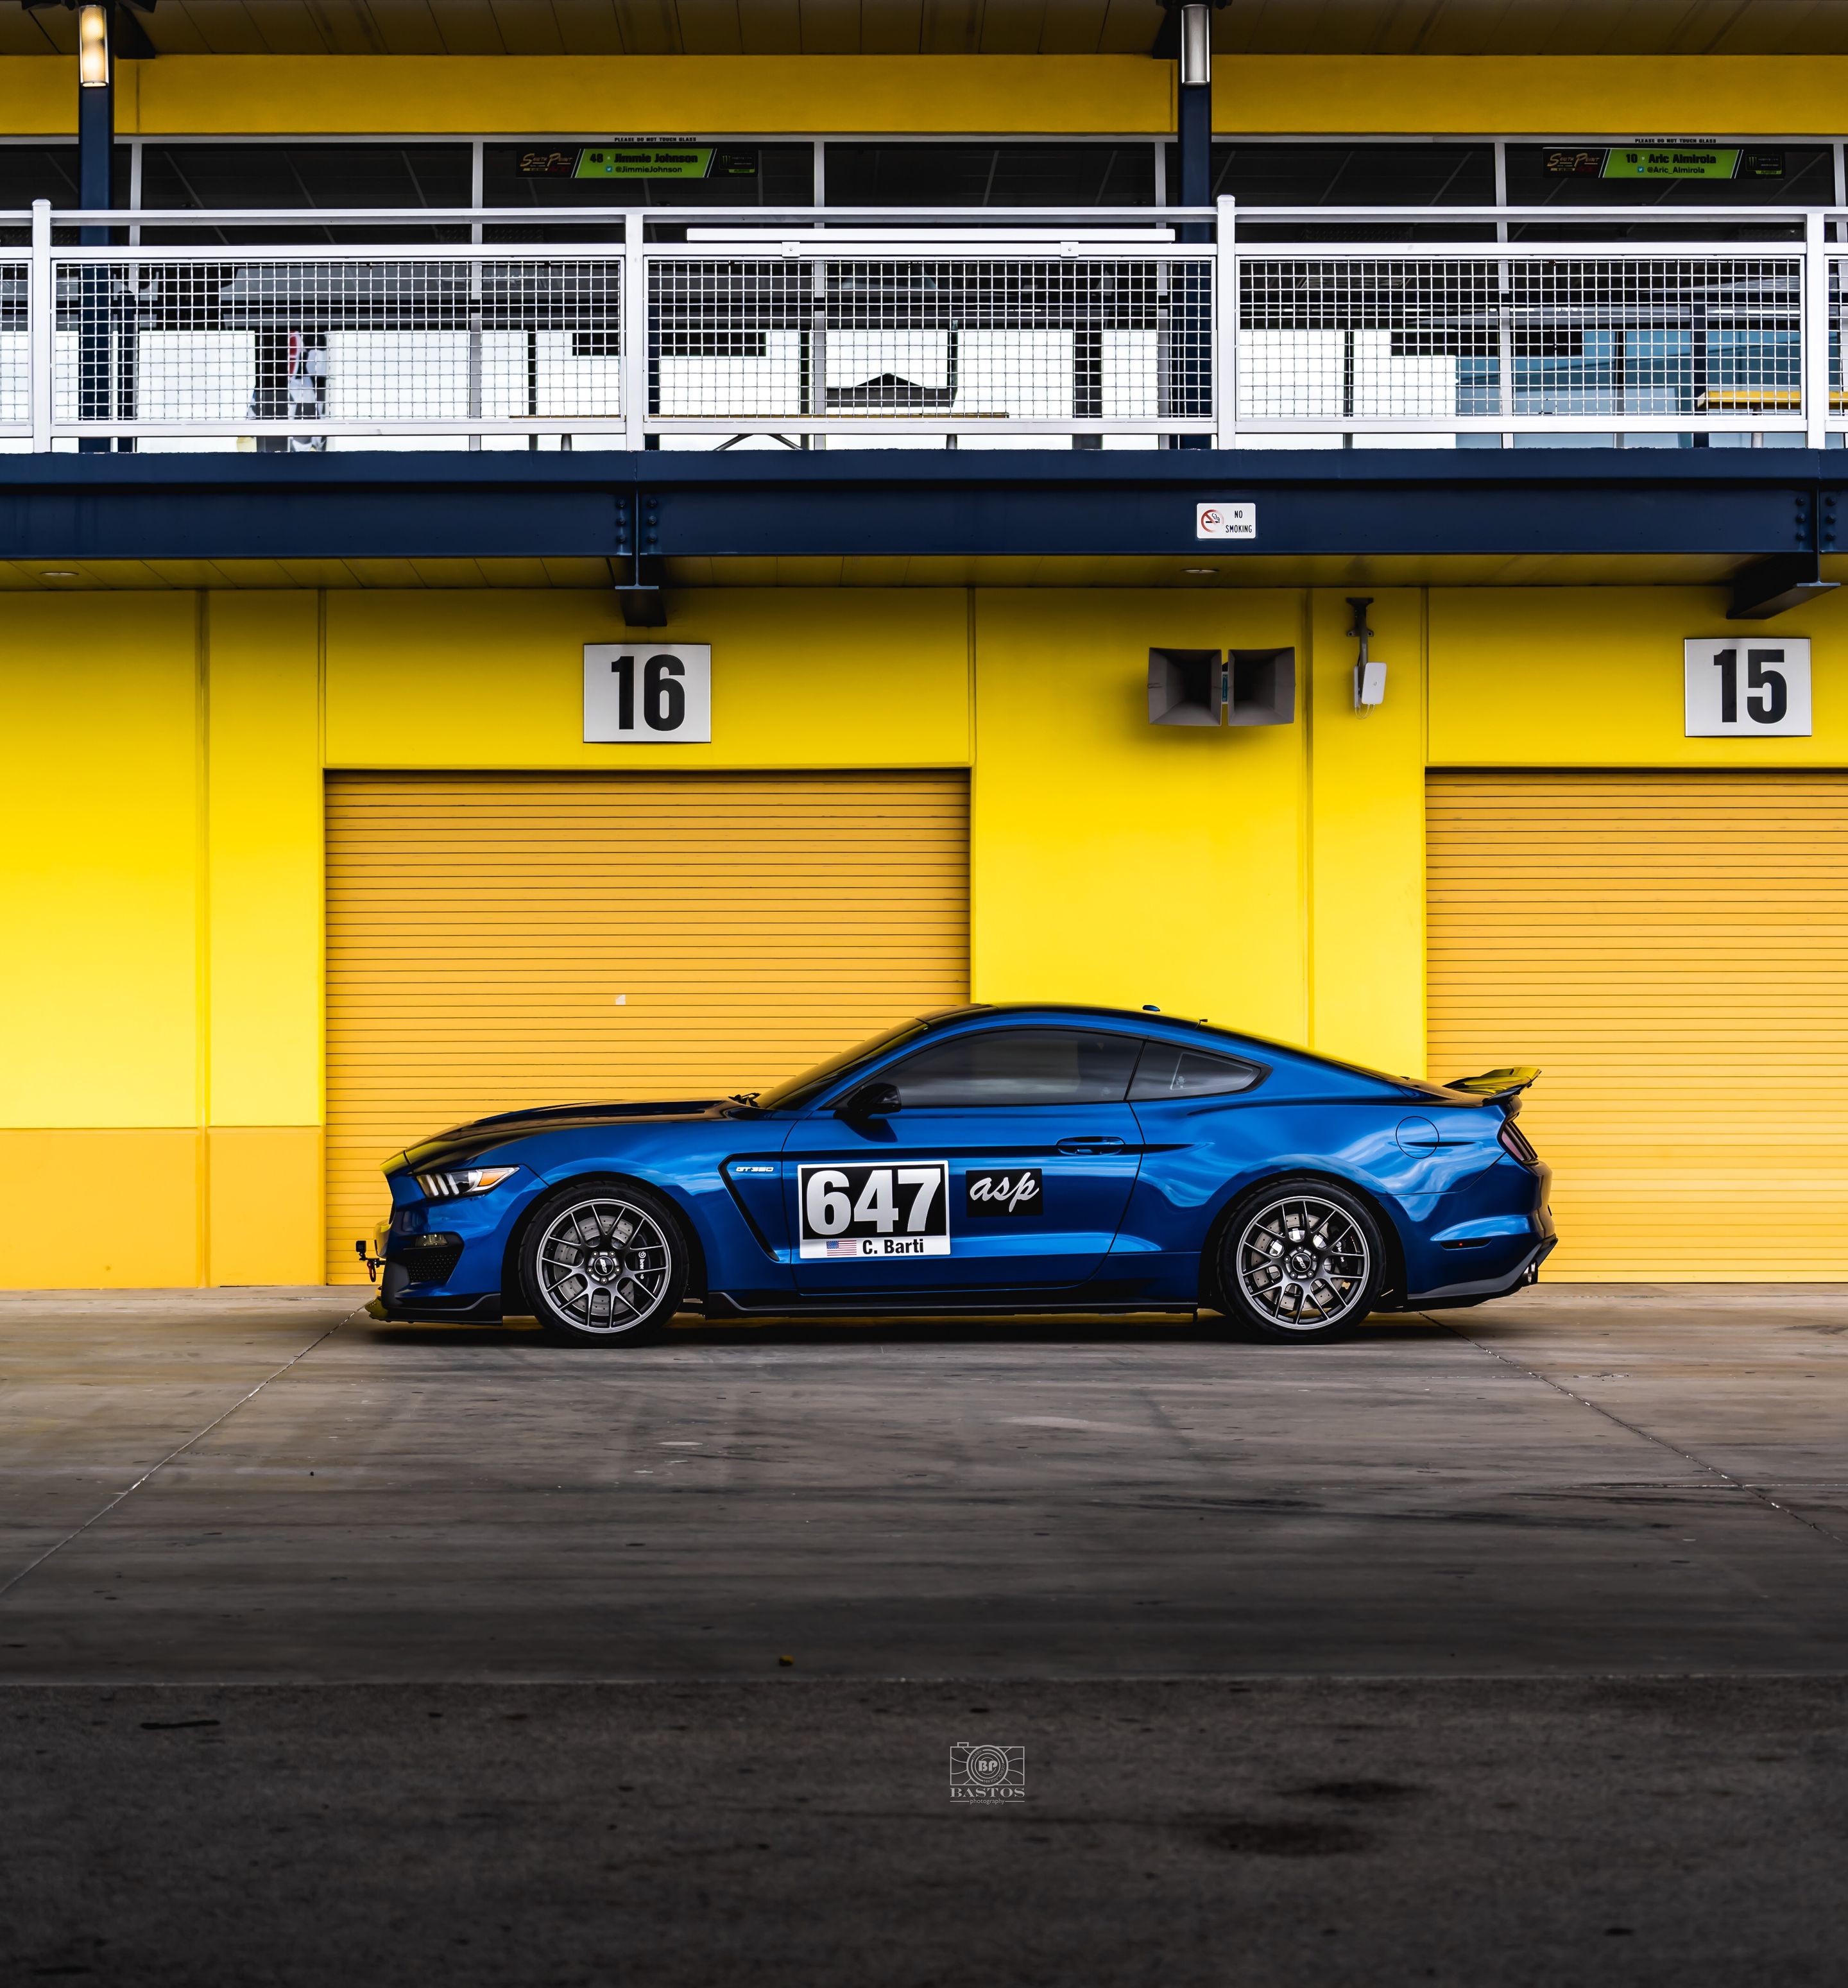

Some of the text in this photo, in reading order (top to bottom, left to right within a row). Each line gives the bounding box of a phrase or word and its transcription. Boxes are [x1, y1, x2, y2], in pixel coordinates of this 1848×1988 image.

[590, 153, 698, 163] 48 Jimmie Johnson
[1625, 153, 1716, 164] 10 Aric Almirola
[1234, 510, 1243, 518] NO
[1225, 525, 1253, 533] SMOKING
[611, 654, 685, 732] 16
[1713, 649, 1787, 724] 15
[969, 1172, 1040, 1212] asp
[806, 1169, 941, 1235] 647
[862, 1239, 924, 1255] C. Barti
